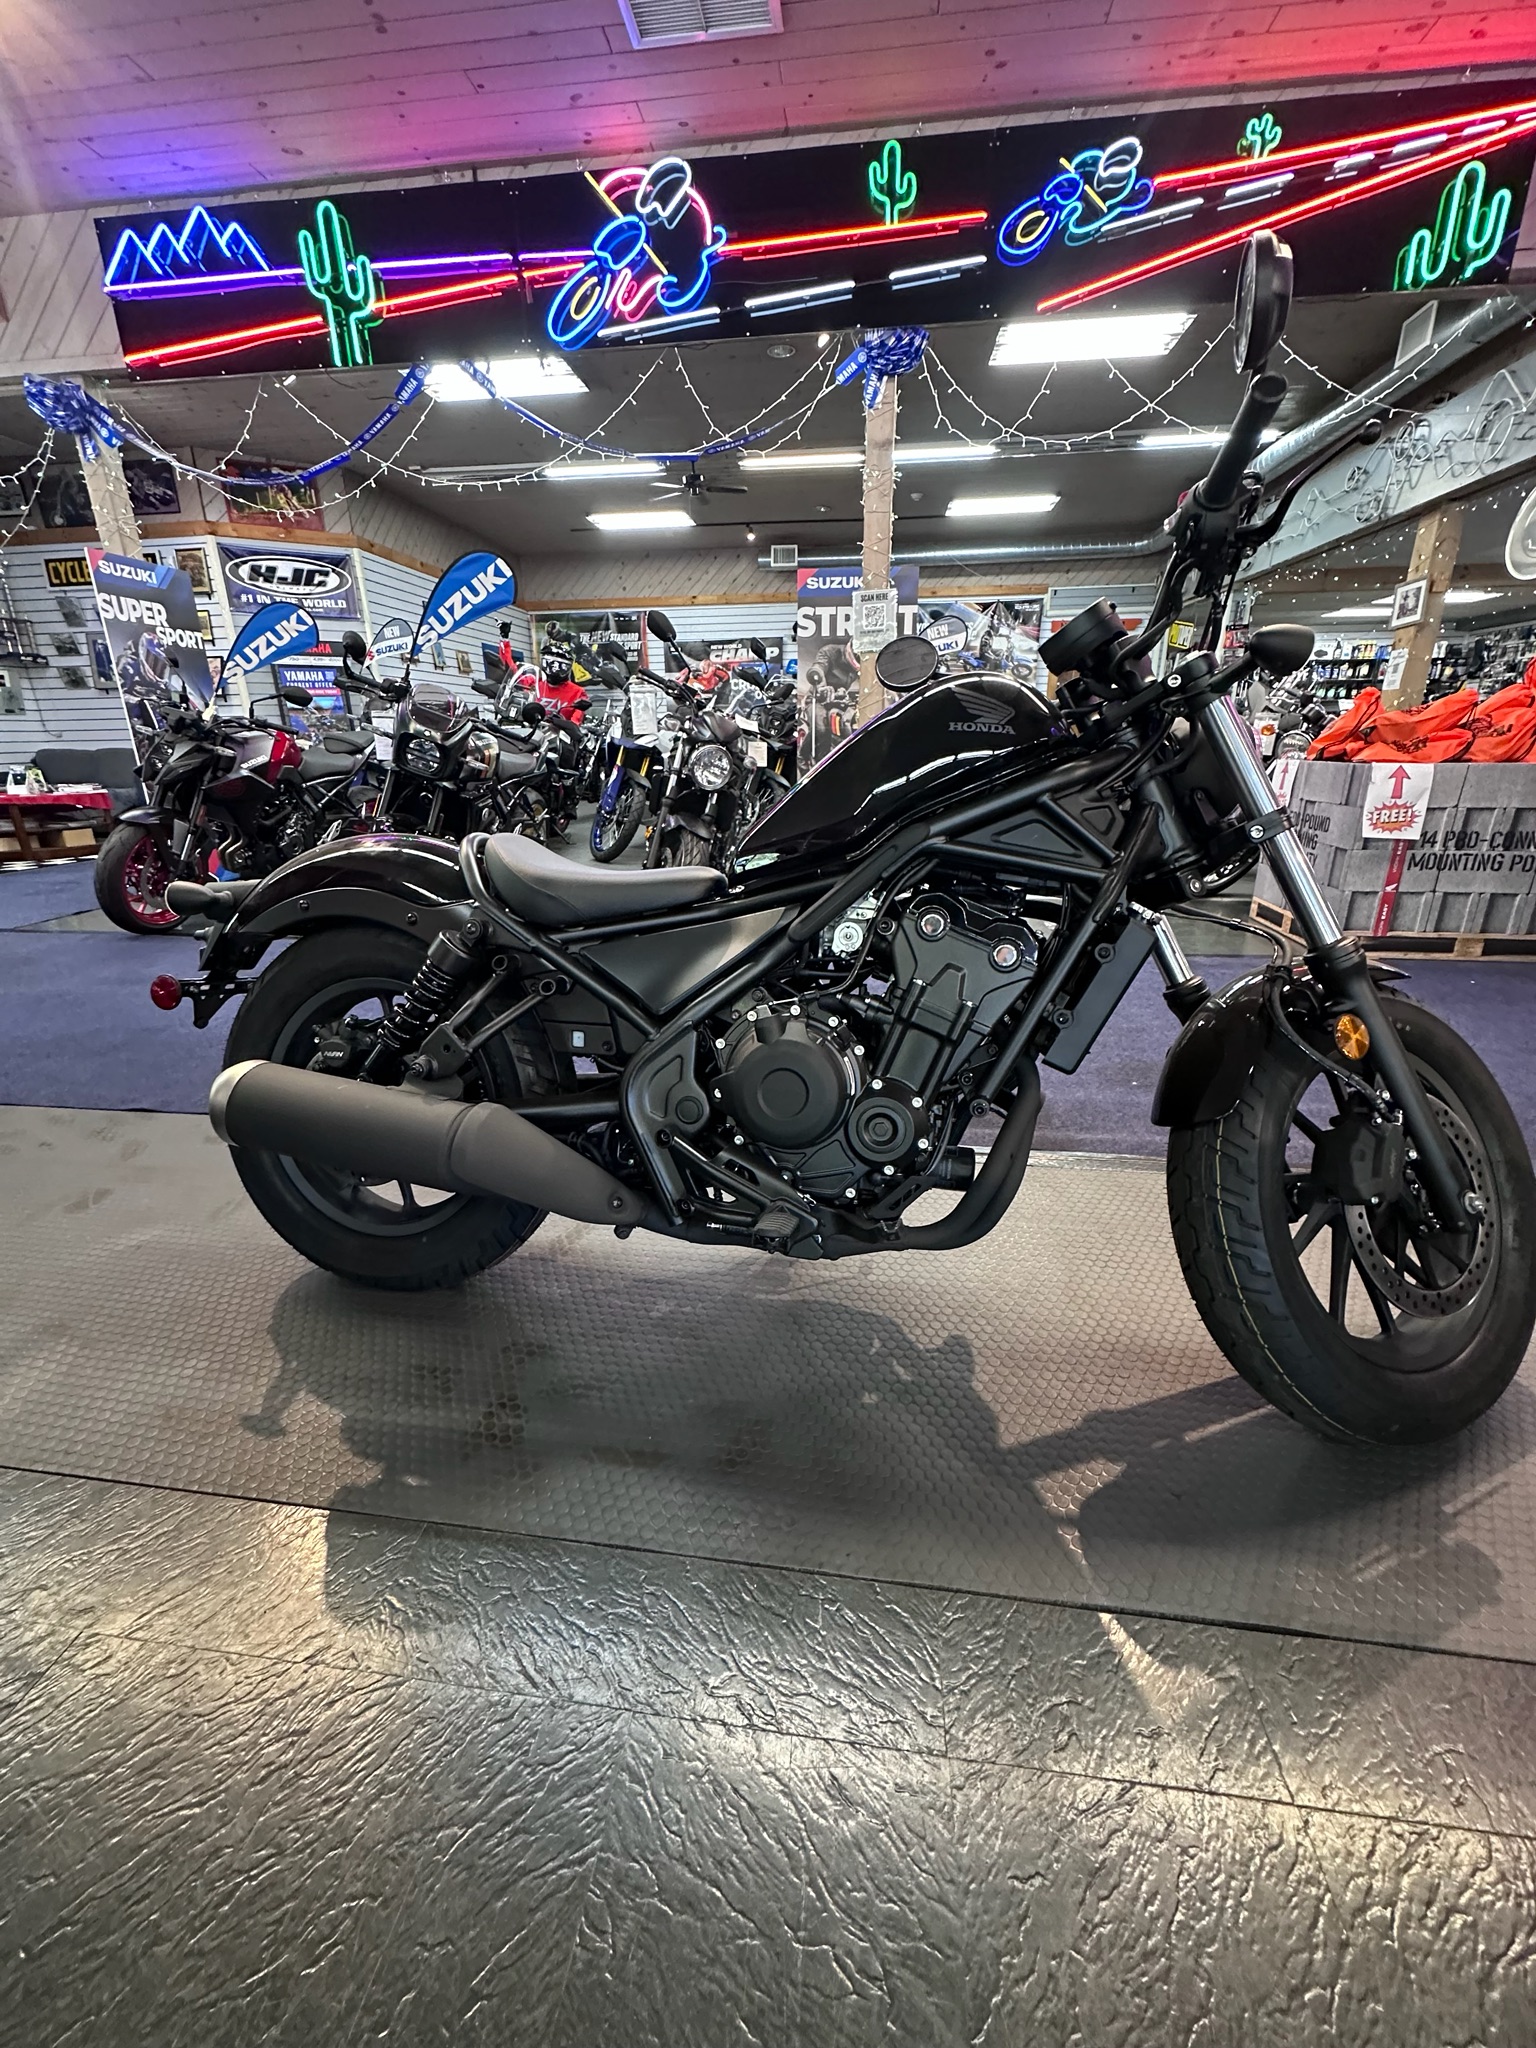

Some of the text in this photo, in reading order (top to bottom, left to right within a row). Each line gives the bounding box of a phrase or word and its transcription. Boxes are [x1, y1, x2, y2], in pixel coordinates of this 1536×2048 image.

[368, 412, 392, 435] YAMAHA
[98, 559, 158, 585] SUZUKI
[248, 564, 332, 587] HJC
[806, 575, 865, 589] SUZUK
[240, 593, 346, 609] #1 IN THE WORLD
[415, 557, 514, 651] SUZUKI
[860, 593, 889, 603] SCAN HERE
[98, 592, 170, 628] SUPER
[797, 605, 919, 638] STRT
[155, 627, 205, 650] SPORT
[383, 625, 401, 639] NEW
[579, 630, 639, 642] THE NEW STANDARD
[927, 623, 949, 640] NEW
[222, 608, 315, 683] SUZUKI
[375, 642, 409, 657] SUZUKI
[624, 641, 643, 650] SPORT
[936, 640, 959, 652] UKI
[284, 671, 325, 682] YAMAHA
[948, 721, 1017, 735] HONDA
[240, 754, 268, 769] SUZUKI
[1372, 808, 1412, 824] FREE!
[1420, 830, 1438, 848] 14
[1407, 852, 1505, 872] MOUNTING
[1380, 903, 1389, 920] EASY
